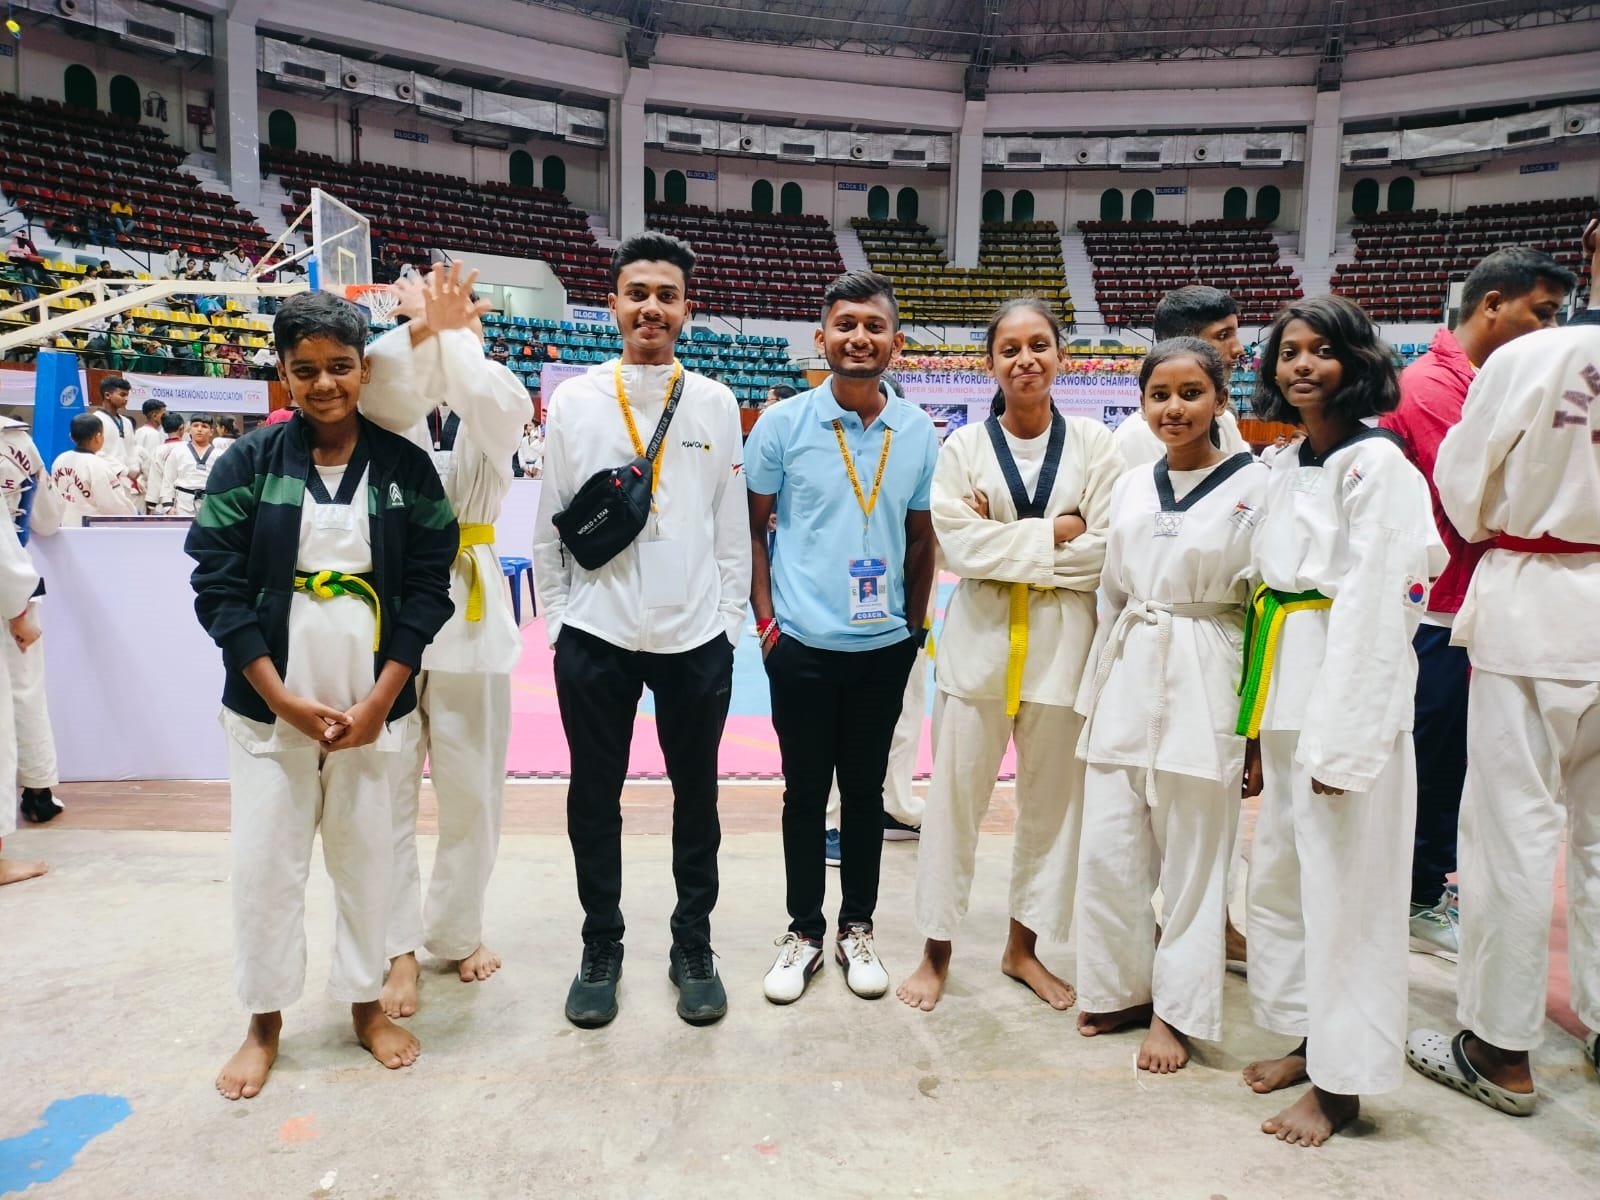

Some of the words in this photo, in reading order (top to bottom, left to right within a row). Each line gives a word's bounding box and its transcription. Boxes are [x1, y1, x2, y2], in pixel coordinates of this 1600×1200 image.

[574, 310, 597, 319] BLOCK
[601, 312, 609, 320] 2
[925, 374, 951, 384] STATE
[953, 374, 991, 384] KYORUGI
[151, 388, 174, 398] ODISHA
[175, 388, 208, 400] TAEKWONDO
[210, 390, 243, 400] ASSOCIATION
[1117, 389, 1137, 397] MALE
[596, 508, 611, 520] STAR
[857, 612, 882, 620] COACH
